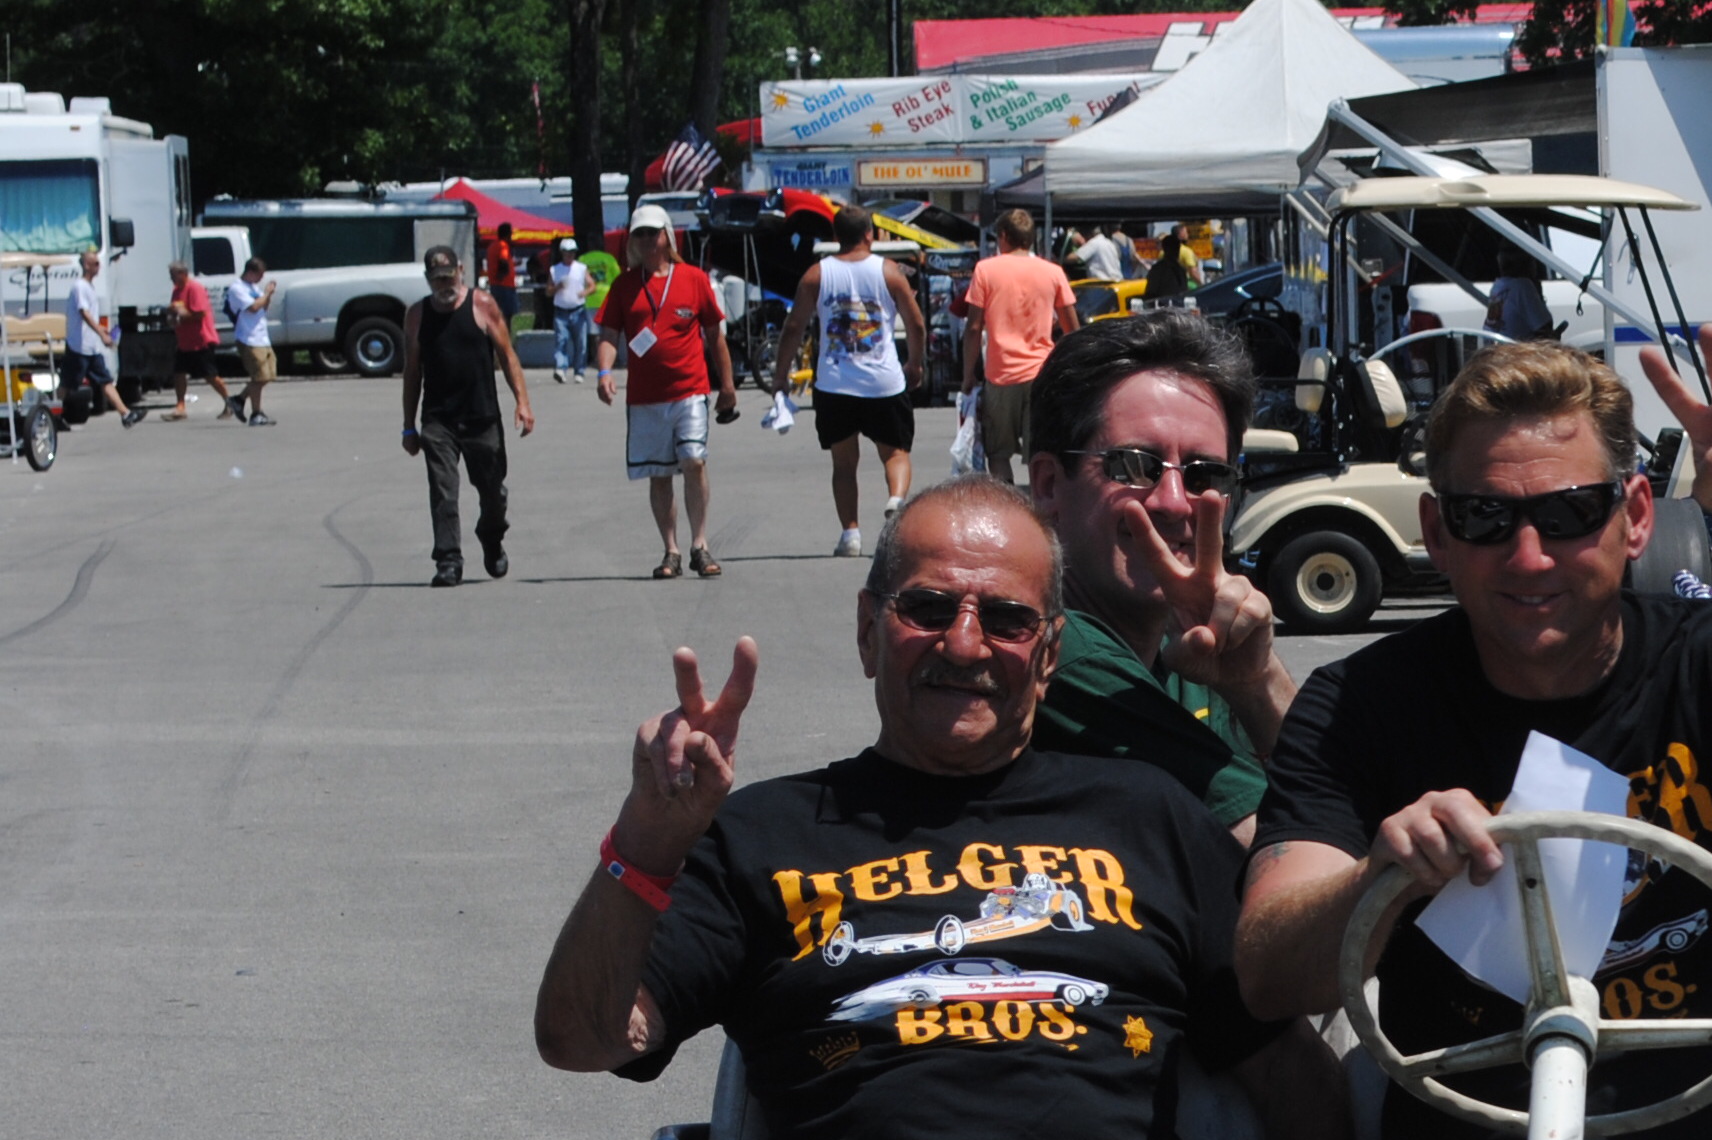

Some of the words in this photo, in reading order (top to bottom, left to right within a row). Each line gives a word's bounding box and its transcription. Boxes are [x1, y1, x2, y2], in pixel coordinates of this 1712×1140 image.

[802, 84, 847, 114] Giant
[892, 96, 920, 118] Rib
[921, 80, 952, 104] Eye
[969, 79, 1019, 108] Polish
[970, 114, 984, 130] &
[985, 91, 1037, 122] Italian
[1005, 92, 1071, 131] Sausage
[1087, 80, 1141, 116] Funl
[790, 92, 875, 140] Tenderloin
[907, 103, 954, 133] Steak
[774, 167, 849, 186] TENDERLOIN
[873, 166, 899, 179] THE
[932, 164, 972, 179] MULE
[772, 842, 1142, 961] HELGER
[1602, 961, 1697, 1020] OS.
[894, 999, 1087, 1046] BROS.
